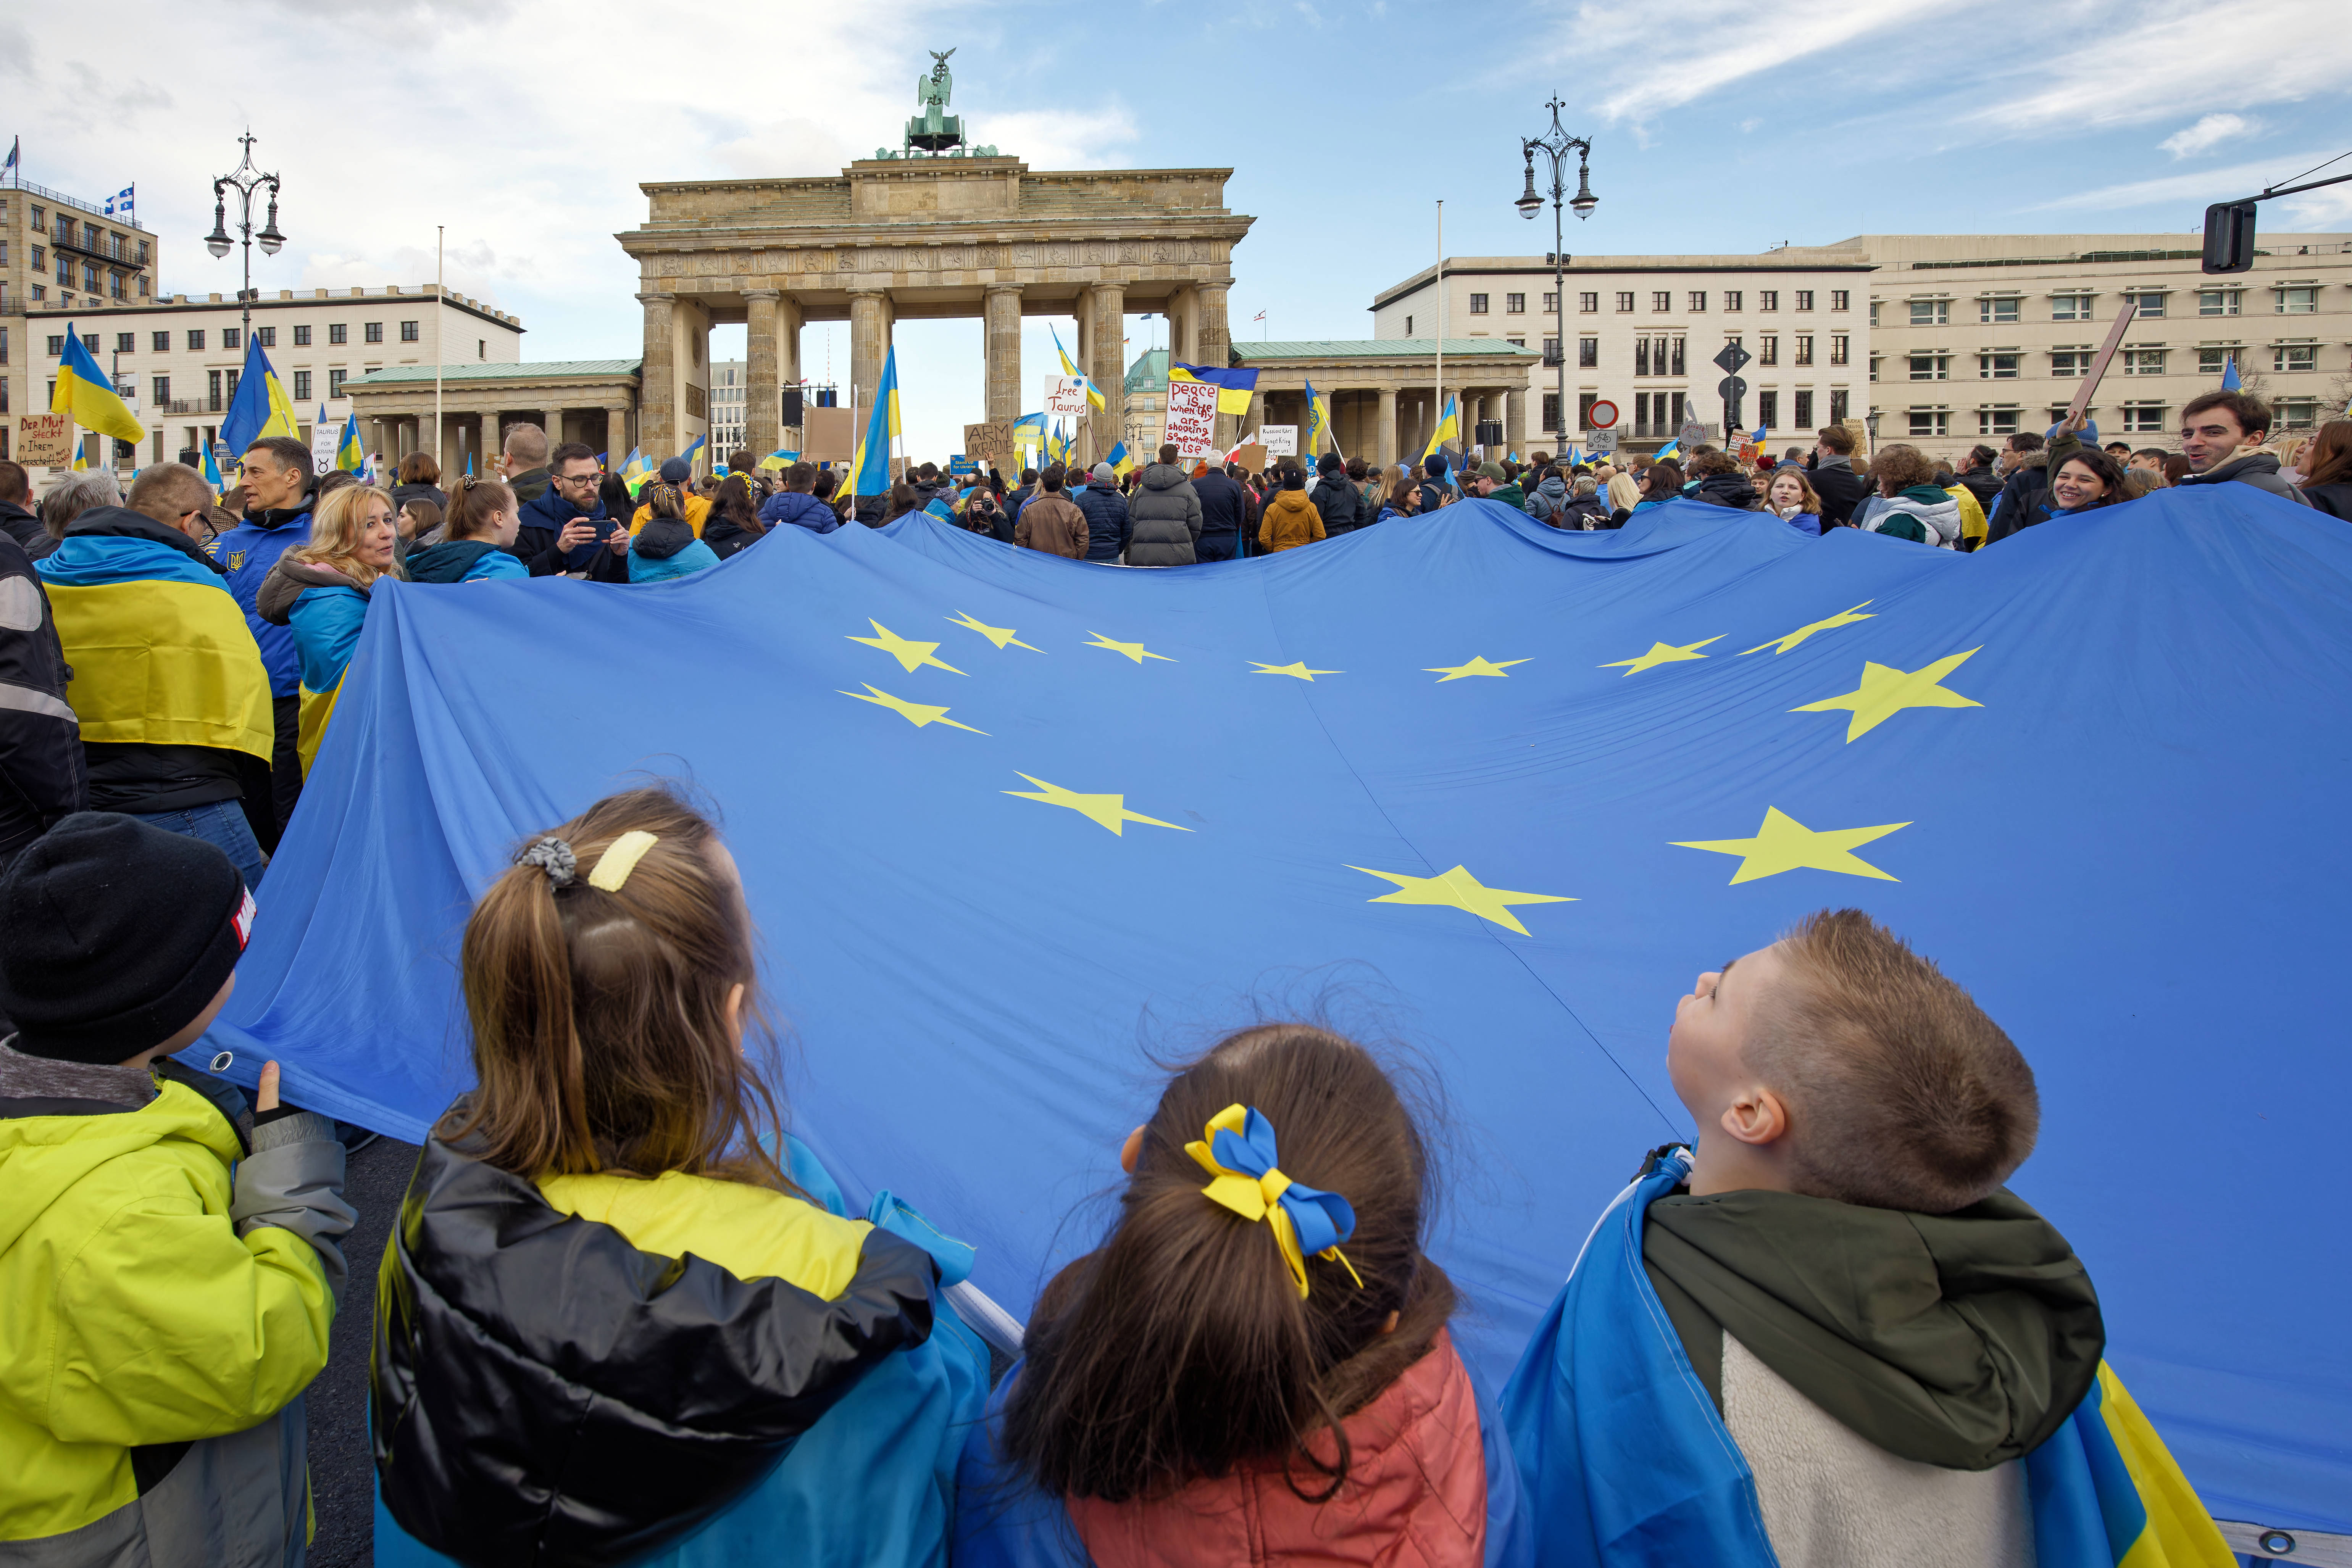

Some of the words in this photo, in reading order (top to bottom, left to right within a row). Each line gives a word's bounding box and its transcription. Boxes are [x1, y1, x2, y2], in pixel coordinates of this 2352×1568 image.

[1048, 396, 1085, 414] Taurus
[42, 415, 65, 428] Mut
[1181, 417, 1199, 426] are
[968, 424, 1009, 442] ARM
[1168, 422, 1208, 437] shooting
[966, 439, 1013, 458] UKRAINE
[1279, 437, 1290, 446] Krieg
[1174, 443, 1202, 455] else
